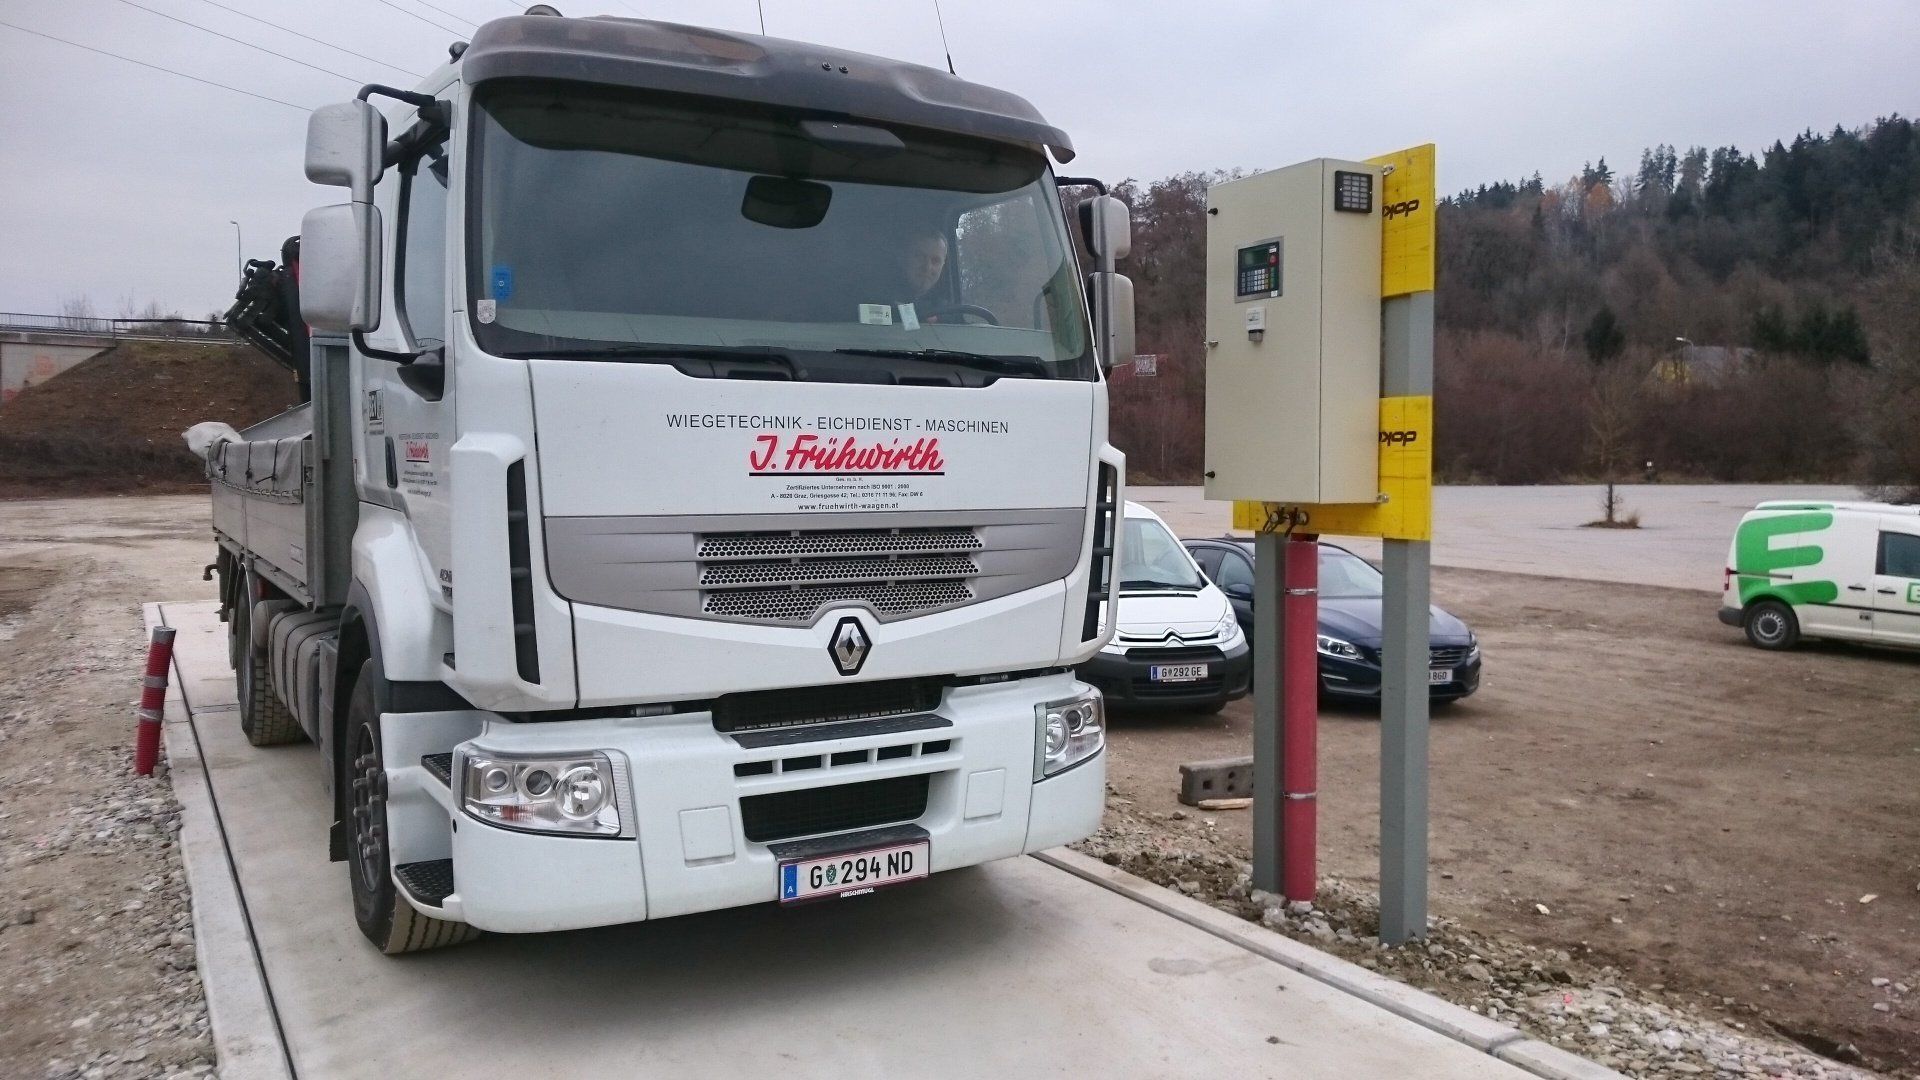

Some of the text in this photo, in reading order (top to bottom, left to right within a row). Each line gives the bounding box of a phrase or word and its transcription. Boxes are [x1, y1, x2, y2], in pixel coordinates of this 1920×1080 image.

[1382, 200, 1419, 220] dok
[666, 414, 803, 430] WIEGETECHNIK
[817, 416, 912, 431] EICHDIENST
[925, 418, 1009, 434] MASCHINEN
[1378, 431, 1417, 447] dok
[750, 434, 944, 471] J. Frühwirth
[809, 492, 840, 500] Griesgasse
[798, 502, 899, 511] www.fruehwirth-waagen.at
[1161, 667, 1167, 678] G
[1173, 667, 1190, 677] 292
[810, 850, 913, 890] G 294 ND
[786, 885, 794, 894] A
